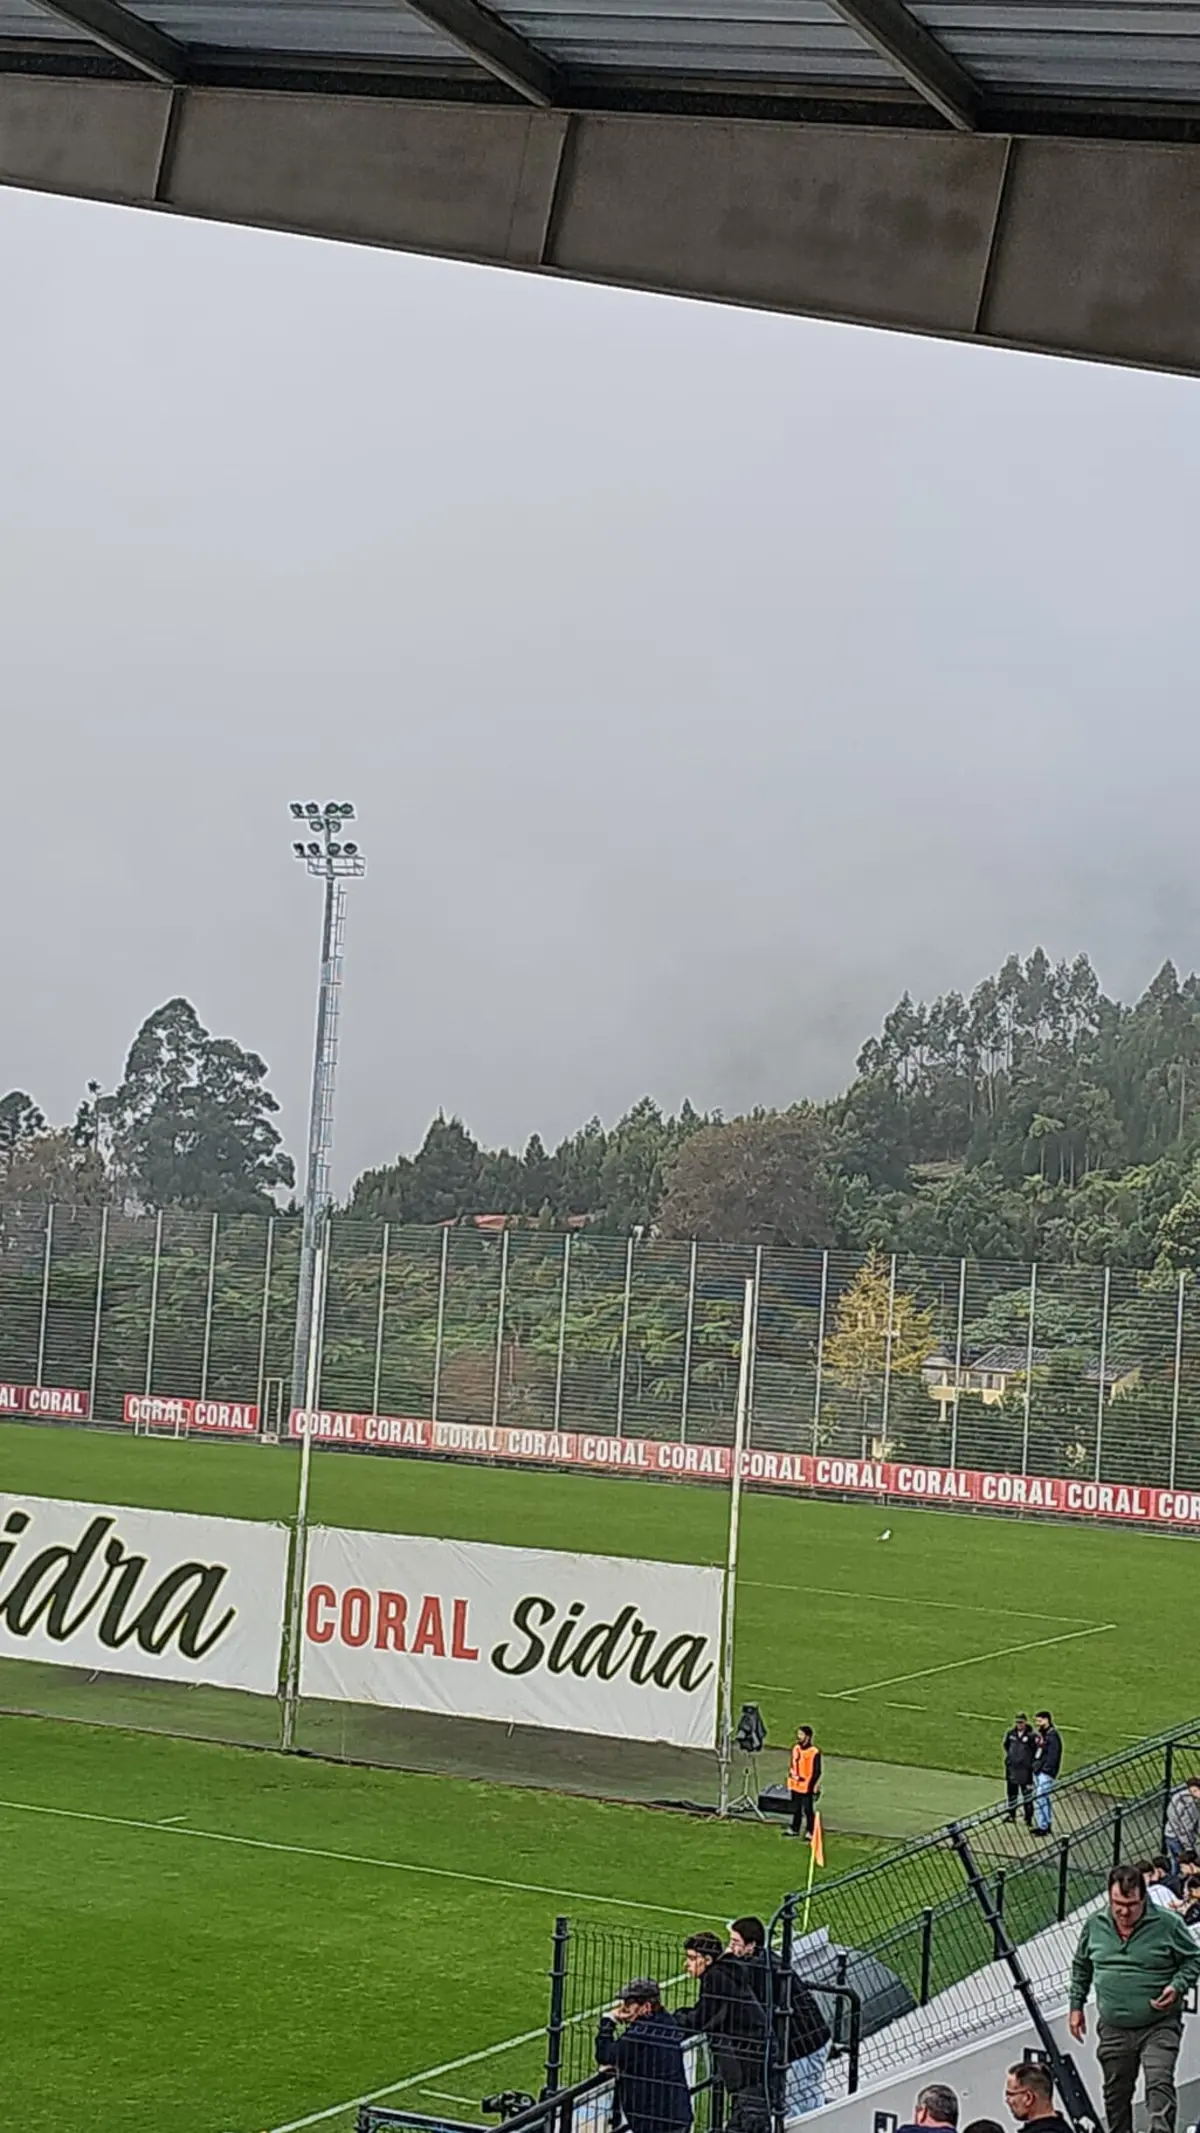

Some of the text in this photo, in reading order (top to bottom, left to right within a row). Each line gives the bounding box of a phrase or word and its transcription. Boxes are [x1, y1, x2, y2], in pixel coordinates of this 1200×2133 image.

[29, 1389, 83, 1413] CORAL
[128, 1397, 253, 1429] CORAL CORAL
[295, 1412, 356, 1438] CORAL
[365, 1418, 427, 1445] CORAL
[436, 1424, 500, 1451] CORAL
[508, 1431, 573, 1458] CORAL
[582, 1438, 649, 1466] CORAL
[658, 1444, 726, 1474] CORAL
[739, 1452, 806, 1481] CORAL
[817, 1460, 888, 1490] CORAL
[898, 1467, 971, 1498] CORAL
[982, 1475, 1058, 1506] CORAL
[1067, 1483, 1145, 1515] CORAL
[306, 1584, 714, 1692] CORAL Sidra
